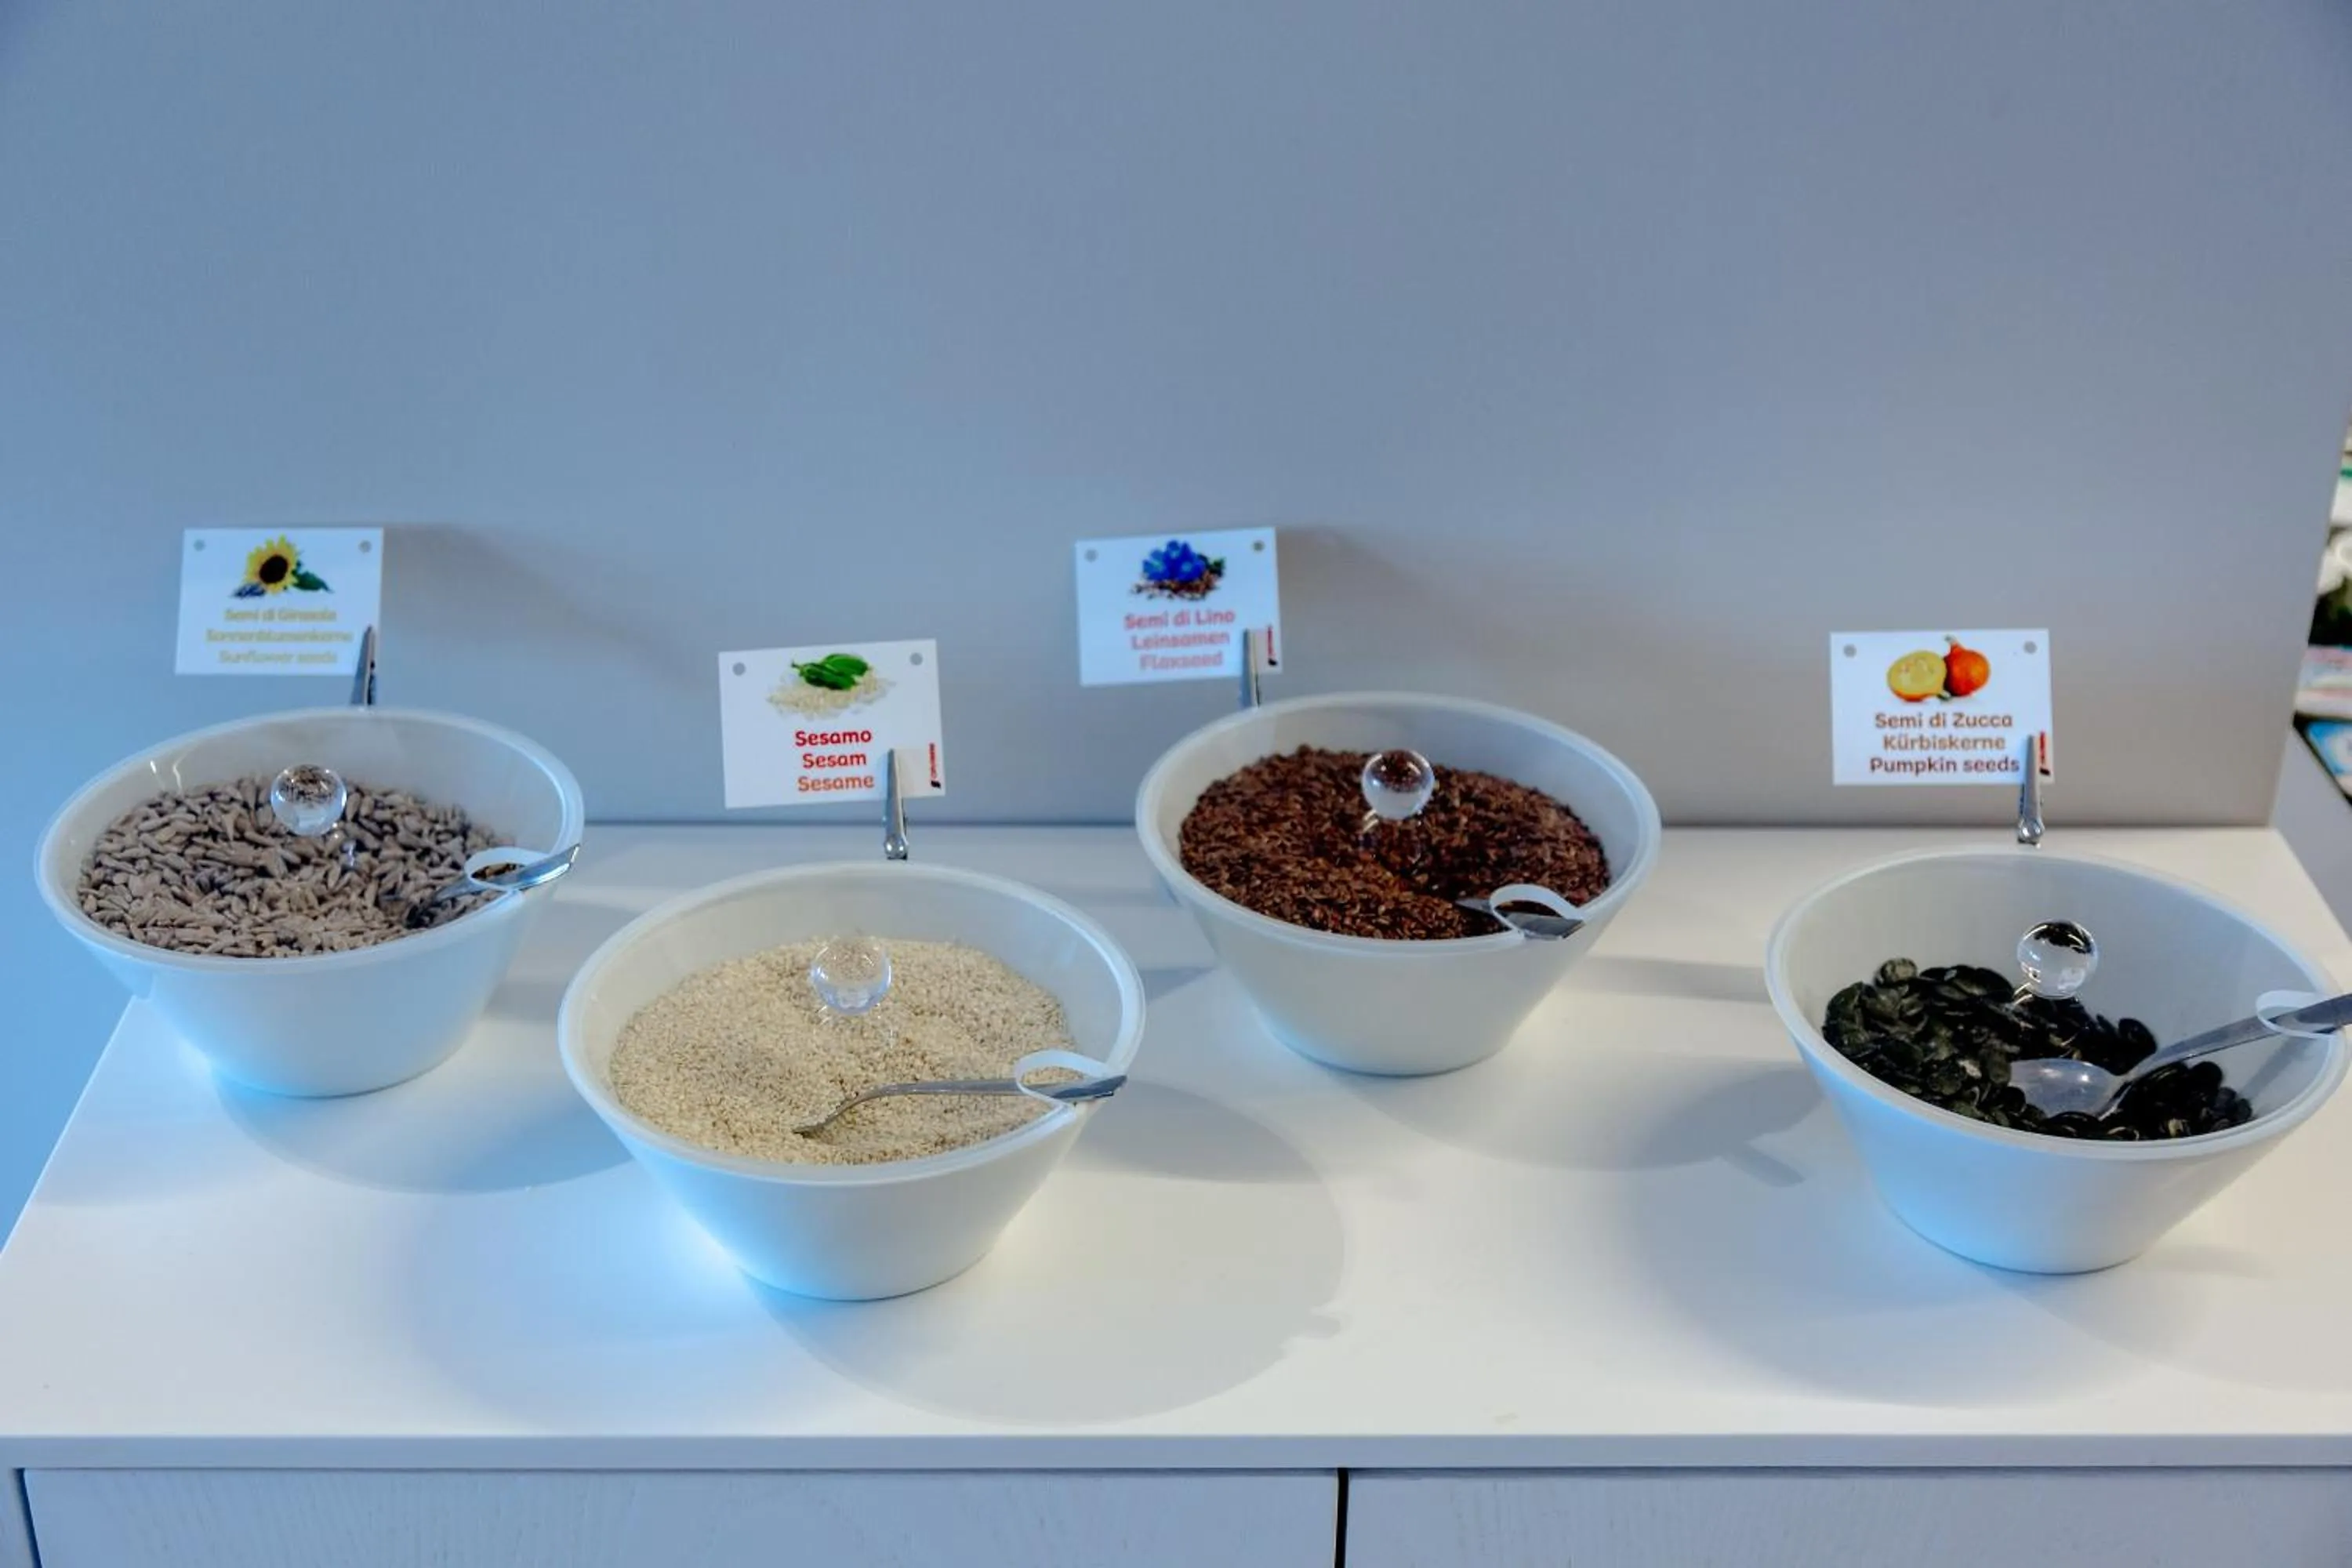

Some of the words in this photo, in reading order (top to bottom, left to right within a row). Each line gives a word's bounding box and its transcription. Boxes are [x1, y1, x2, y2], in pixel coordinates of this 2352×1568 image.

[1123, 612, 1168, 630] Semi
[1173, 609, 1191, 626] di
[1196, 608, 1236, 626] Lino
[1131, 632, 1230, 650] Leinsamen
[1875, 713, 1922, 728] Semi
[1929, 713, 1947, 728] di
[1952, 713, 2013, 728] Zucca
[794, 729, 873, 746] Sesamo
[1882, 733, 2005, 750] Kürbiskerne
[802, 752, 867, 769] Sesam
[1869, 755, 1958, 776] Pumpkin
[1962, 757, 2020, 773] seeds
[797, 774, 875, 793] Sesame
